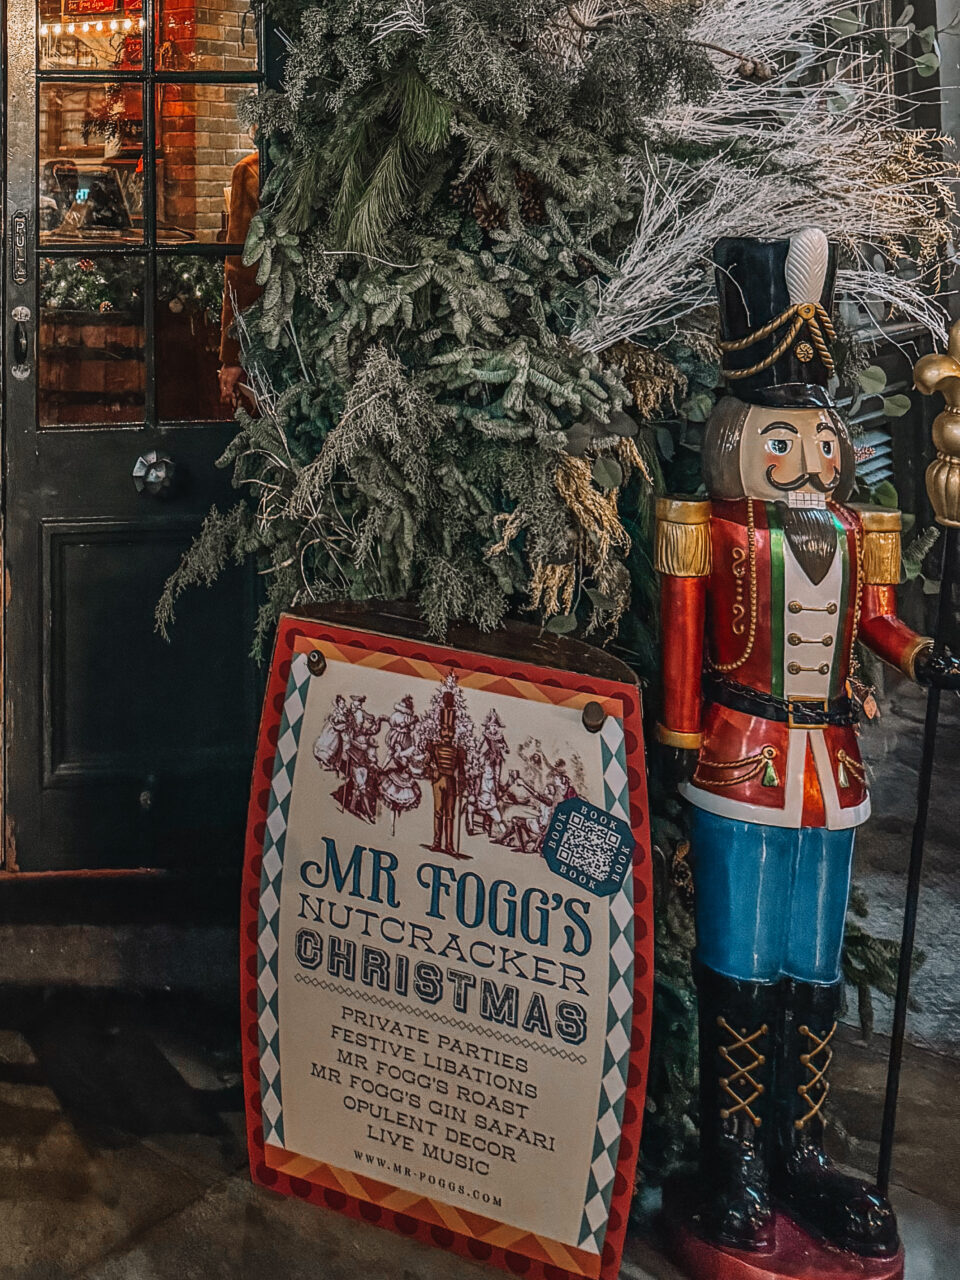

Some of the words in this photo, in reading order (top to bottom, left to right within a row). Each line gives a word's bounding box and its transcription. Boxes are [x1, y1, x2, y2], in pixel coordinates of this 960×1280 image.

[15, 221, 25, 275] PULL
[548, 812, 567, 849] BOOK
[580, 805, 618, 830] BOOK
[300, 836, 401, 908] MR
[416, 862, 592, 957] FOGG'S
[559, 864, 597, 889] BOOK
[611, 845, 631, 882] BOOK
[297, 892, 590, 997] NUTCRACKER
[295, 927, 588, 1046] CHRISTMAS
[330, 1024, 415, 1062] FESTIVE
[423, 1052, 538, 1099] LIBATIONS
[341, 1005, 429, 1044] PRIVATE
[437, 1034, 528, 1073] PARTIES
[310, 1062, 342, 1085] MR
[349, 1074, 421, 1108] FOGG'S
[428, 1100, 467, 1124] GIN
[474, 1114, 556, 1152] SAFARI
[336, 1048, 368, 1071] MR
[376, 1060, 449, 1095] FOGG'S
[456, 1084, 530, 1120] ROAST
[343, 1095, 438, 1137] OPULENT
[445, 1126, 518, 1163] DECOR
[366, 1124, 415, 1152] LIVE
[422, 1142, 490, 1176] MUSIC
